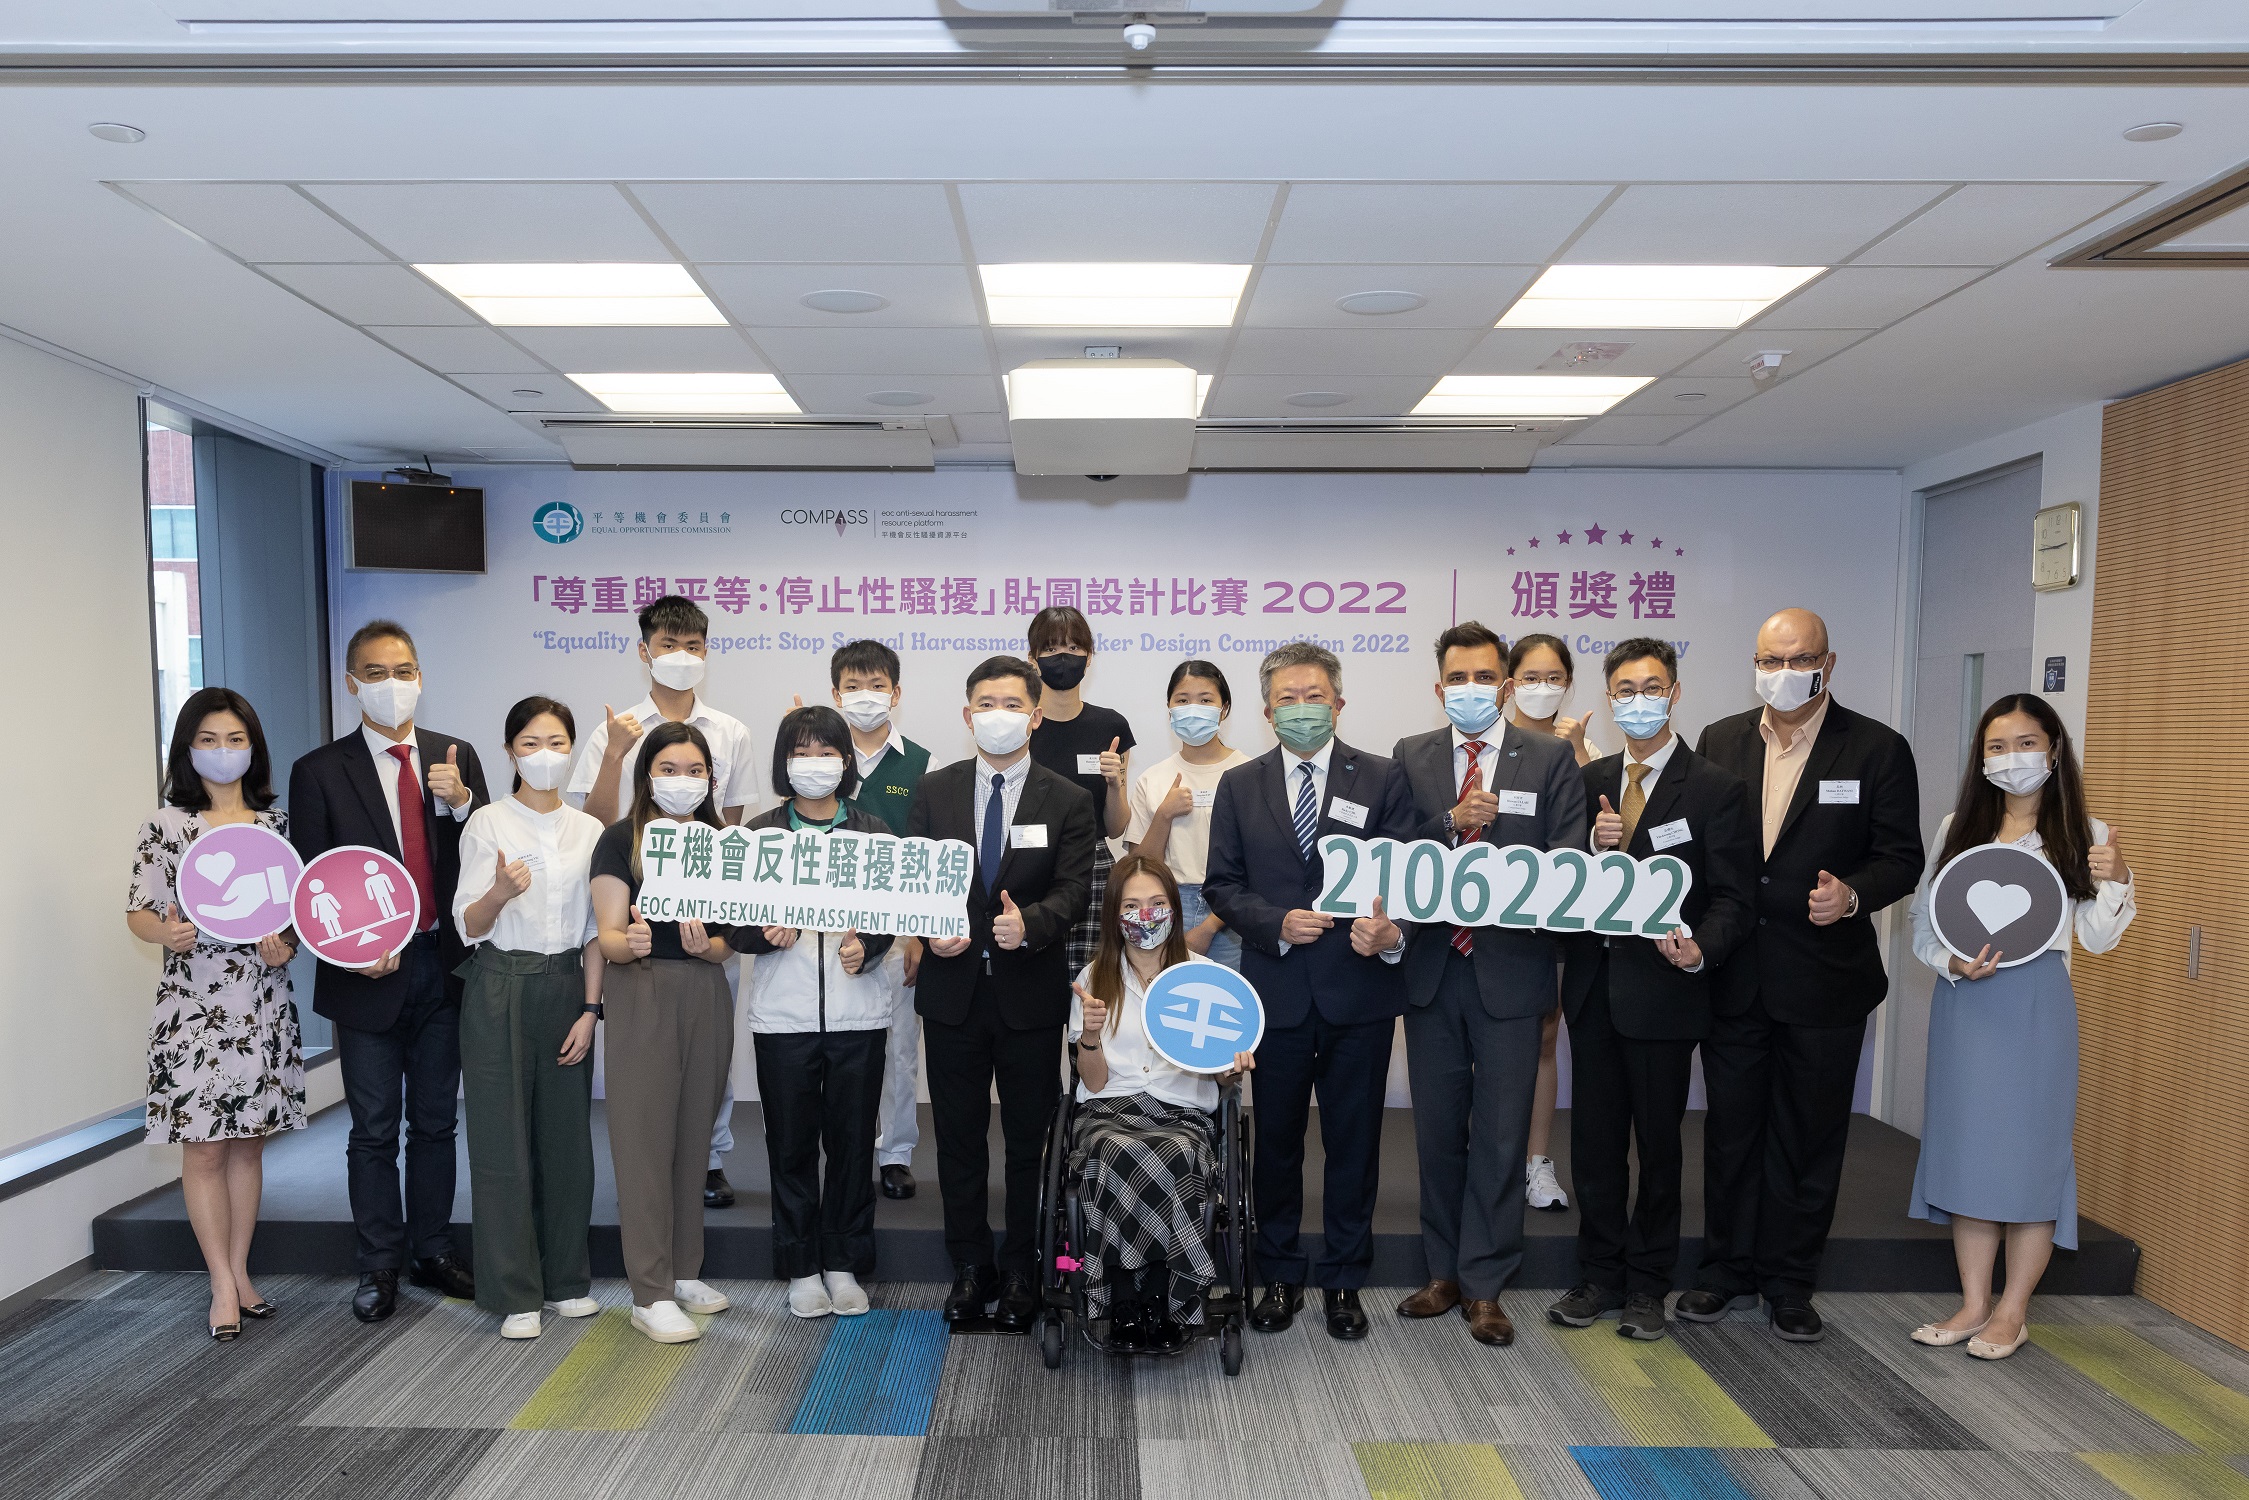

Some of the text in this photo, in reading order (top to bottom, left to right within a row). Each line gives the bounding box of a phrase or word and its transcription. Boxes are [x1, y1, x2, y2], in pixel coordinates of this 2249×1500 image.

[592, 511, 731, 524] 平等機會委員會
[780, 509, 868, 525] COMPASS
[895, 509, 935, 517] anti-sexual
[935, 509, 978, 517] harassment
[913, 519, 944, 528] platform
[592, 526, 731, 535] EQUAL OPPORTUNITIES COMMISSION
[1262, 581, 1407, 614] 2022
[1510, 570, 1675, 619] 頒獎禮
[532, 630, 630, 654] “Equality
[704, 633, 771, 655] spect:
[778, 631, 825, 654] Stop
[911, 632, 1030, 651] Harassmen
[1140, 633, 1211, 656] Design
[1352, 633, 1410, 653] 2022
[886, 785, 909, 797] SSCC
[645, 826, 969, 897] 平機會反性騷擾熱線
[1319, 837, 1684, 935] 21062222
[640, 896, 965, 937] EOC ANTI-SEXUAL HARASSMENT HOTLINE
